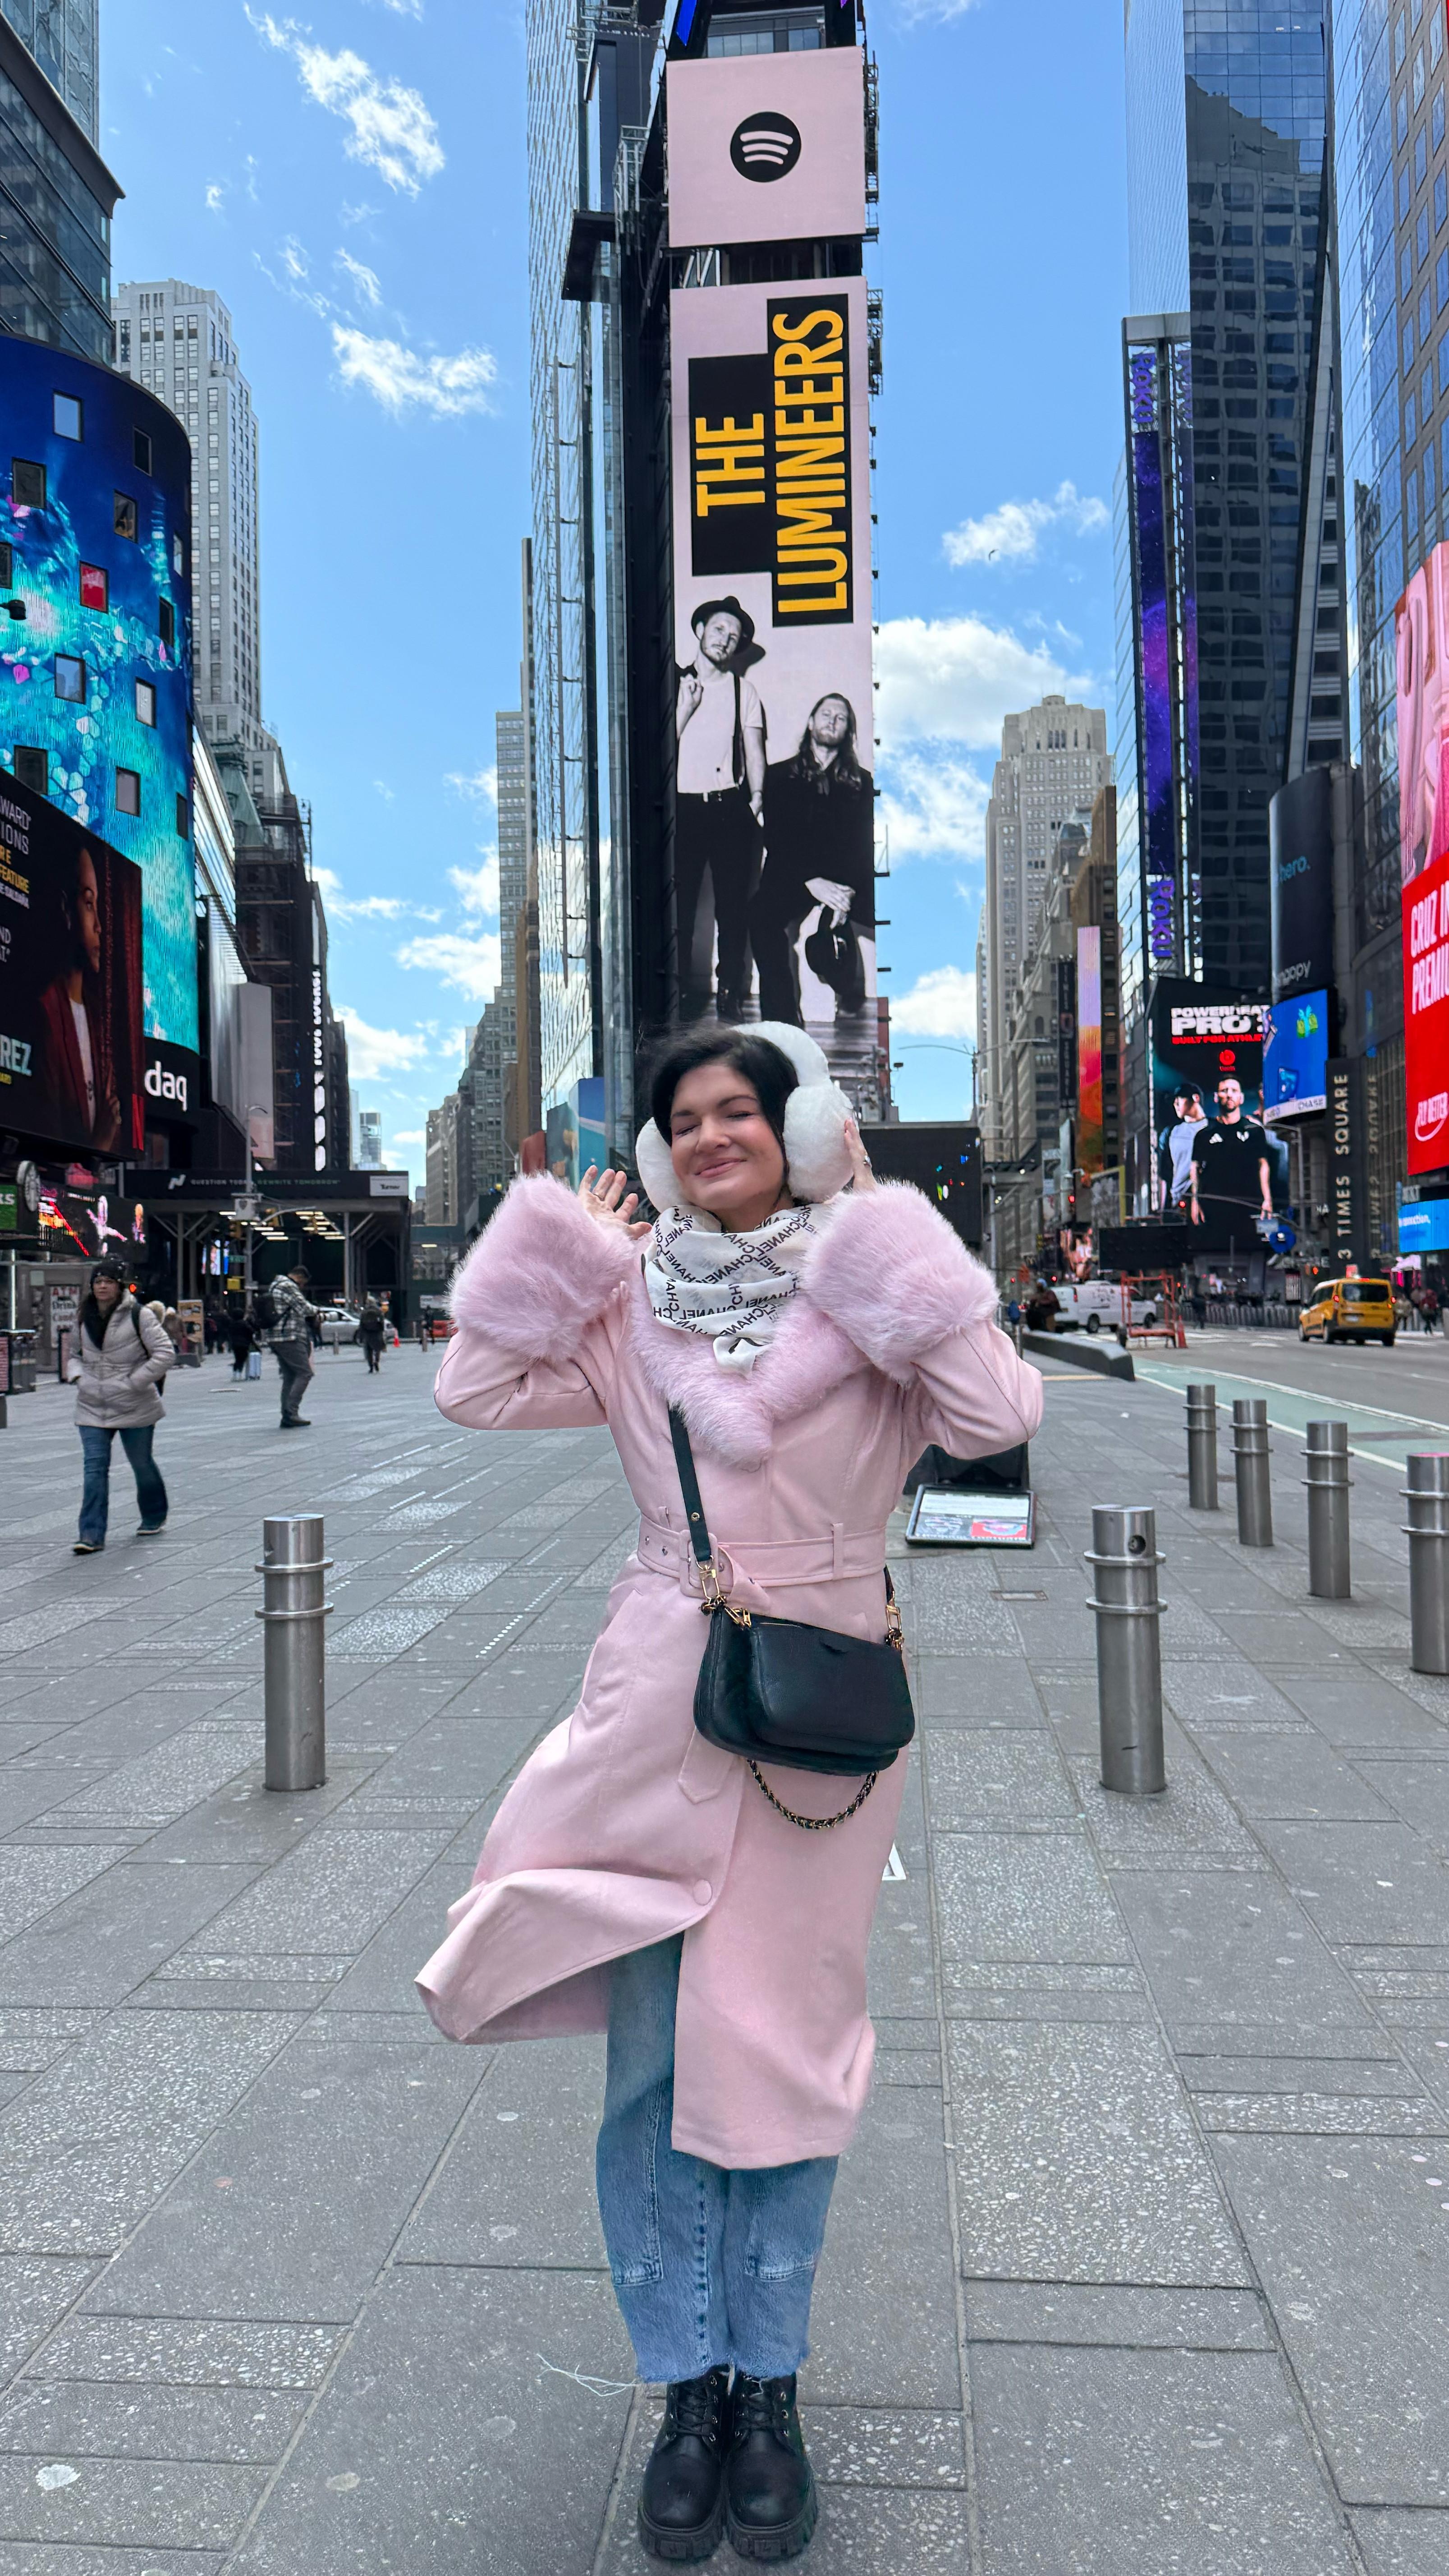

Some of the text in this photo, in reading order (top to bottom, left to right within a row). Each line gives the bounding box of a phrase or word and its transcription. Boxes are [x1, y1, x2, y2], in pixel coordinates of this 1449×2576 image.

[1131, 353, 1156, 423] Roku
[696, 412, 765, 517] THE
[772, 310, 848, 613] LUMINEERS
[1151, 880, 1175, 957] Roku
[1411, 890, 1438, 958] CRUZ
[1171, 1015, 1252, 1036] PRO
[1334, 1074, 1352, 1260] 3 TIMES SQUARE
